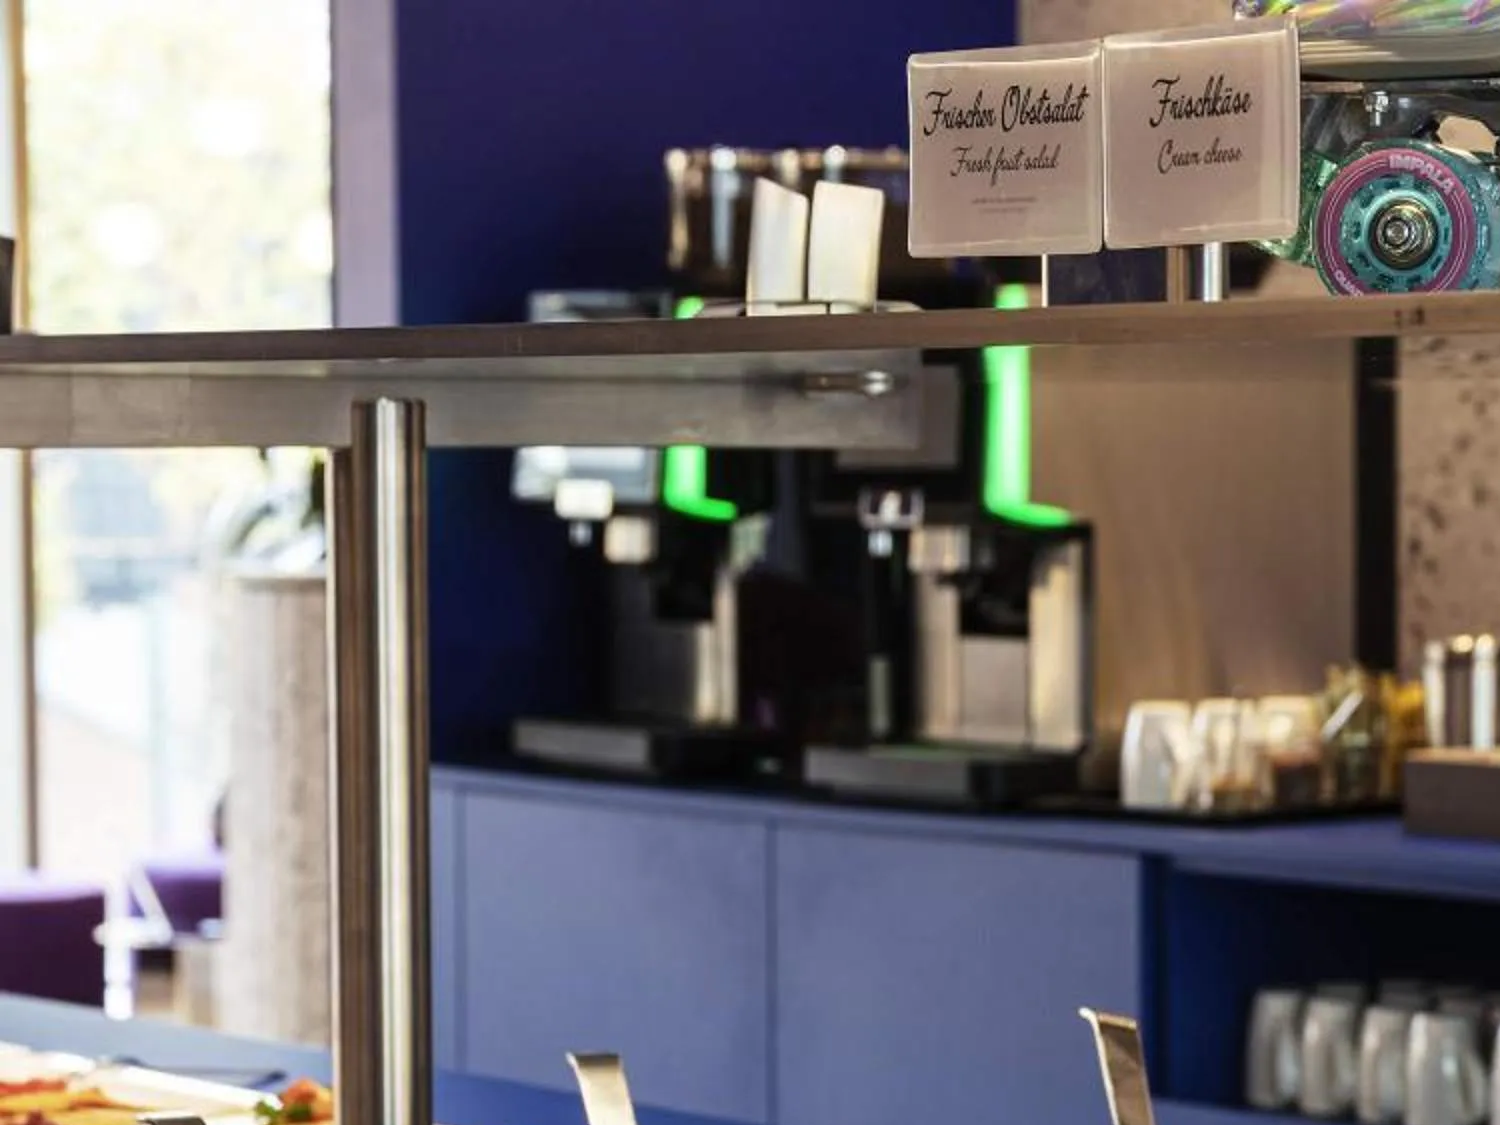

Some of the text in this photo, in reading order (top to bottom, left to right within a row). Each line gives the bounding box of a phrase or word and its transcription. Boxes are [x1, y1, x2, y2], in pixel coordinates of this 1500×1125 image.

[923, 82, 1090, 136] Frischer Obstsalat
[1149, 73, 1252, 128] Frischkäse
[951, 144, 1061, 187] Fresh fruit salad
[1157, 136, 1243, 174] Cream cheese
[1389, 154, 1456, 197] IMPALA
